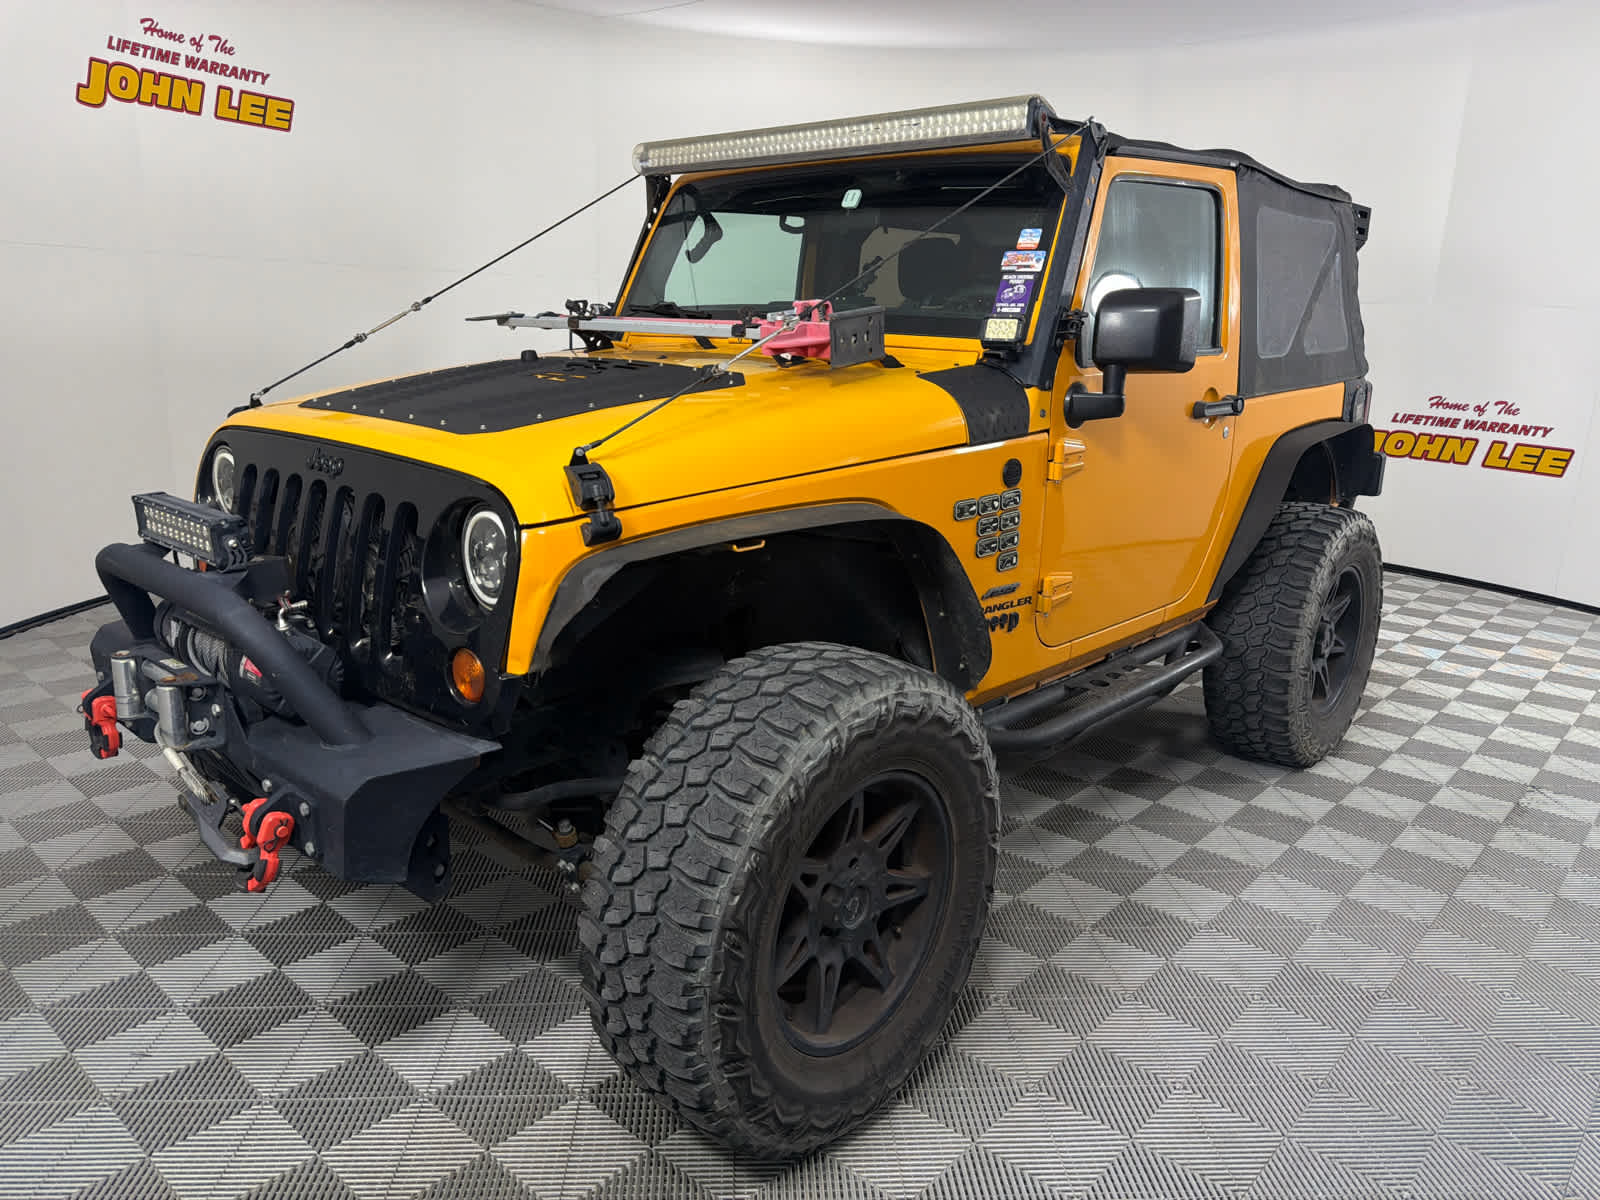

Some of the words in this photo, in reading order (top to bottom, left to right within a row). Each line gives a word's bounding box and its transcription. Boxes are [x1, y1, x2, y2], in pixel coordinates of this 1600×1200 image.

[140, 18, 185, 44] Home
[189, 34, 204, 52] of
[208, 35, 236, 56] The
[107, 36, 180, 66] LIFETIME
[184, 54, 270, 86] WARRANTY
[76, 57, 206, 117] JOHN
[214, 85, 295, 133] LEE
[1428, 396, 1470, 412] Home
[1473, 401, 1489, 417] of
[1494, 401, 1520, 417] The
[1391, 412, 1461, 430] LIFETIME
[1463, 418, 1554, 438] WARRANTY
[308, 447, 345, 476] Jeep
[1481, 440, 1575, 478] LEE
[988, 612, 1020, 633] eep
